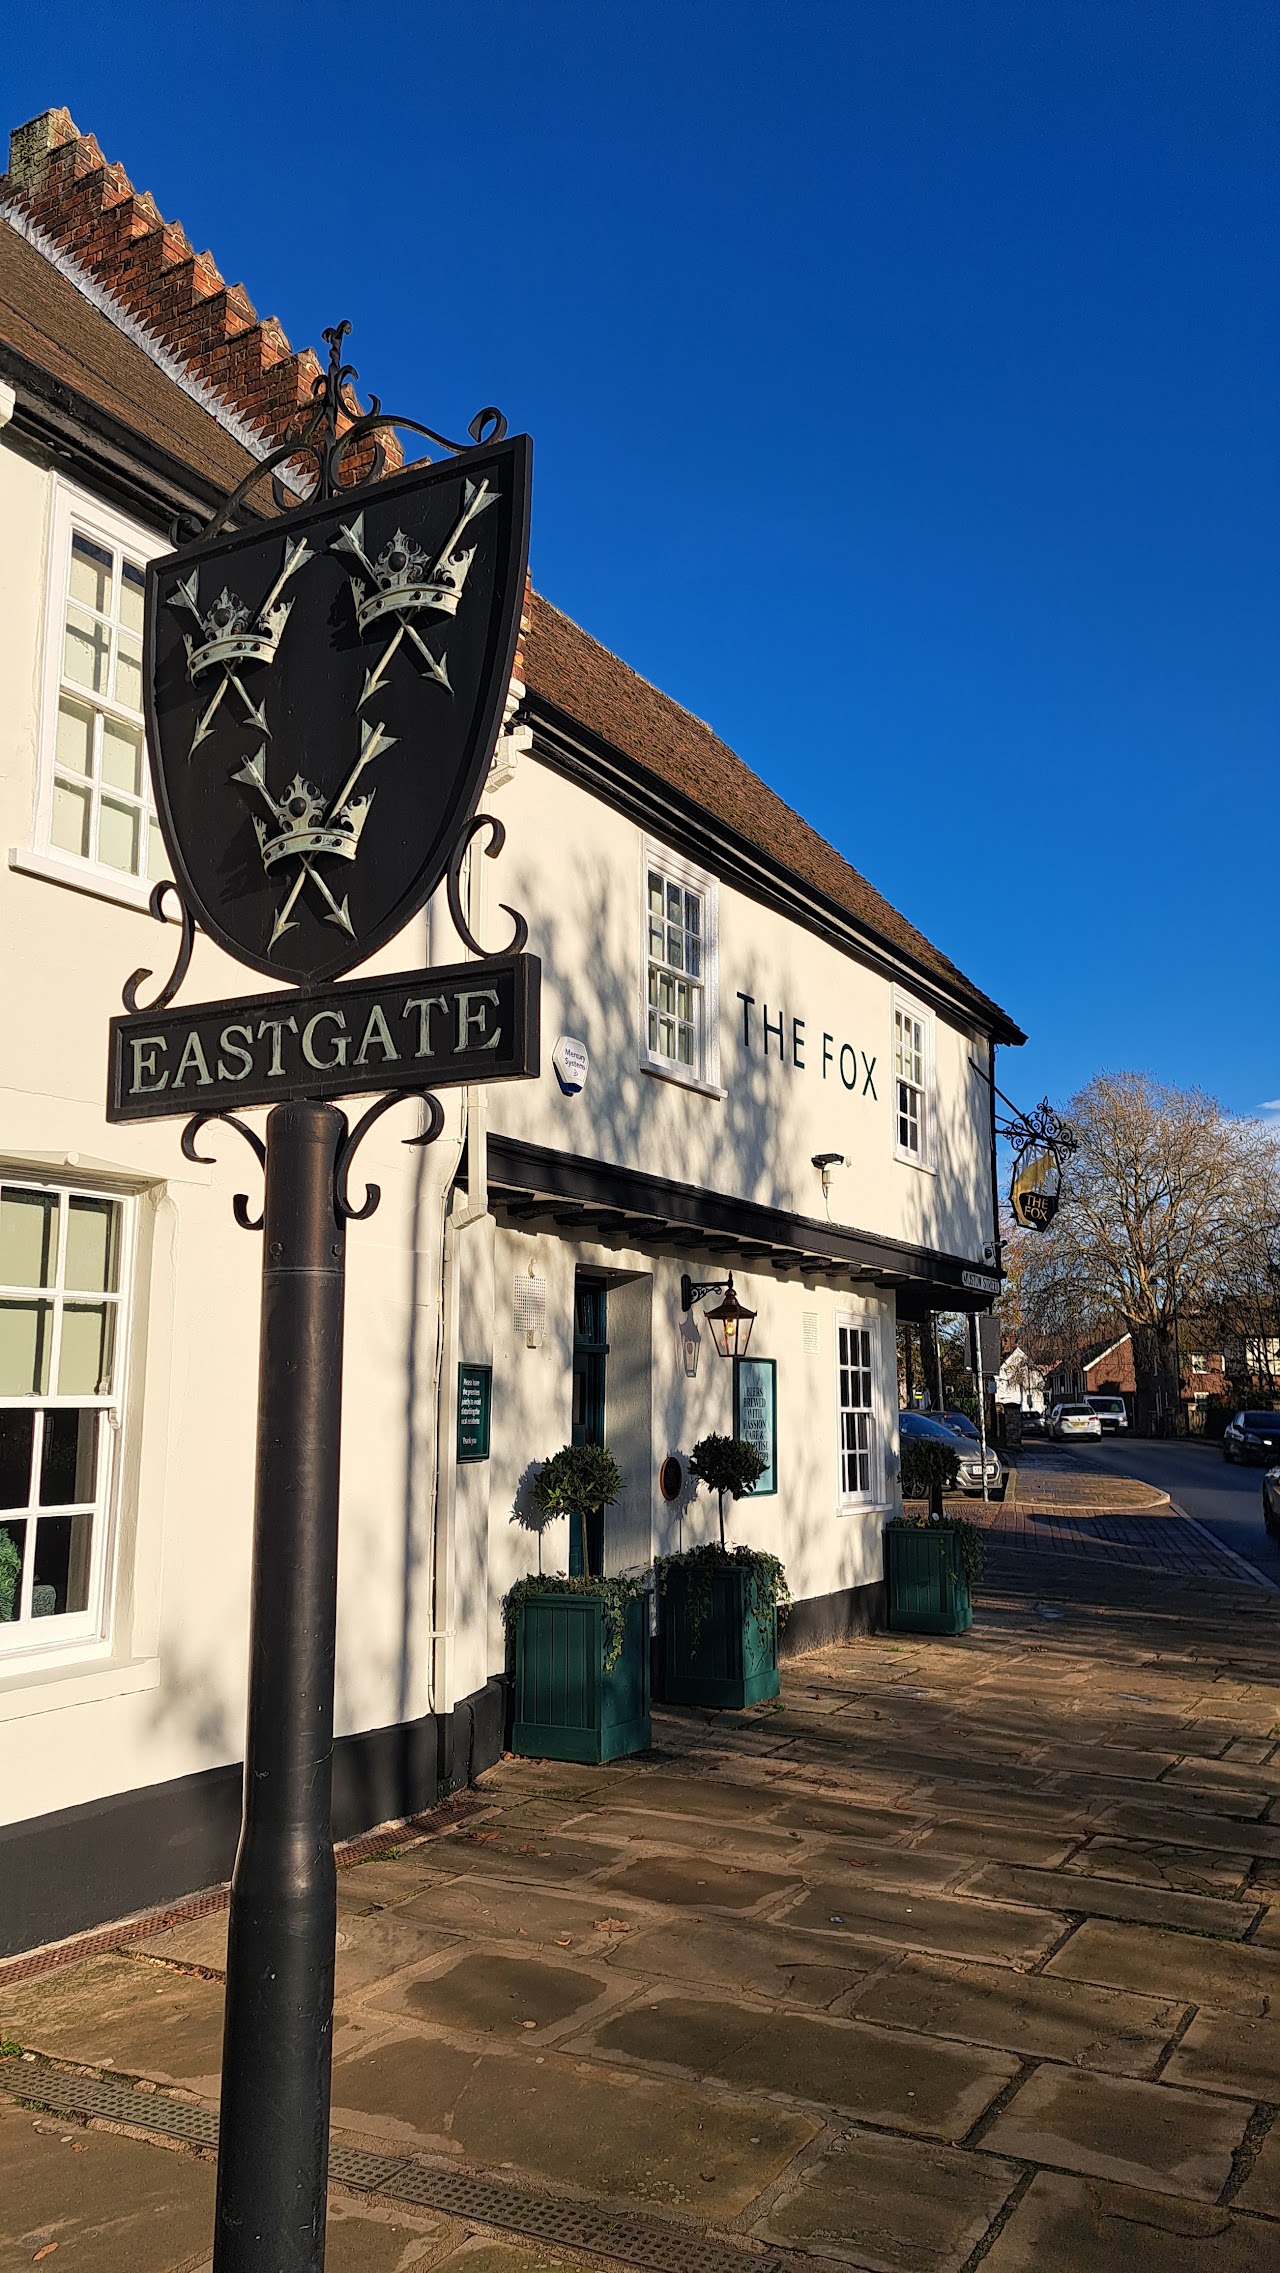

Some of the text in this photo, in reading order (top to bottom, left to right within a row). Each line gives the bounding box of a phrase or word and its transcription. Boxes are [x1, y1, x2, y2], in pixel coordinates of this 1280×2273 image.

[128, 989, 501, 1095] EASTGATE
[737, 991, 878, 1102] THE FOX
[564, 1048, 586, 1064] Mercury
[564, 1057, 586, 1071] Systems
[1026, 1194, 1049, 1210] THE
[1024, 1205, 1048, 1222] FOX
[746, 1387, 763, 1396] BEERS
[744, 1398, 766, 1407] BREWED
[747, 1409, 762, 1418] WITH
[743, 1420, 766, 1429] PASSION
[760, 1430, 764, 1440] &
